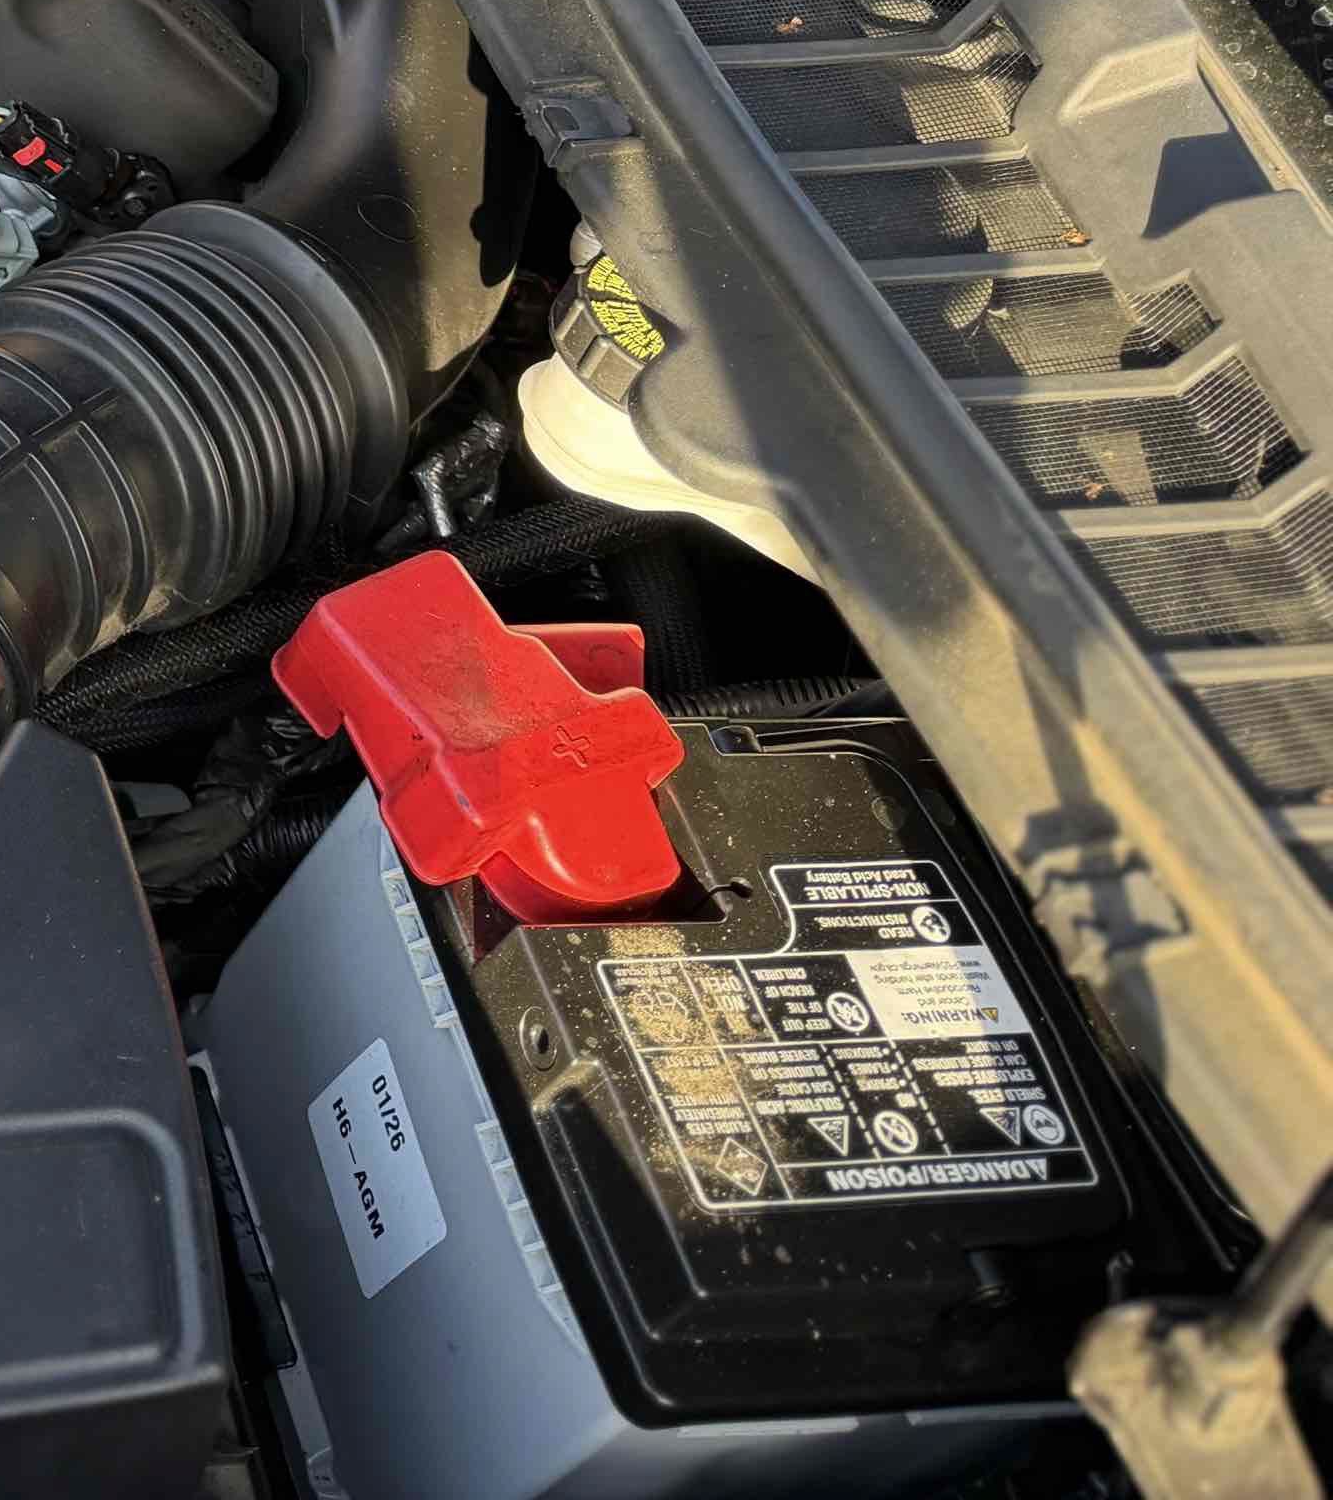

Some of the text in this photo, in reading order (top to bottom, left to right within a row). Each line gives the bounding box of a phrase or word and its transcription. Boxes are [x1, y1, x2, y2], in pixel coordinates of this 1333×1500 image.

[806, 869, 916, 885] Lead Acid Battery
[804, 882, 931, 901] NON-SPILLABLE
[878, 927, 914, 939] READ
[900, 1008, 986, 1024] WARNING:
[974, 1069, 1036, 1083] EXPLOSIVE
[1004, 1088, 1046, 1100] SHIELD
[372, 1074, 405, 1152] 01/26
[826, 1159, 1031, 1191] DANGER/POISON
